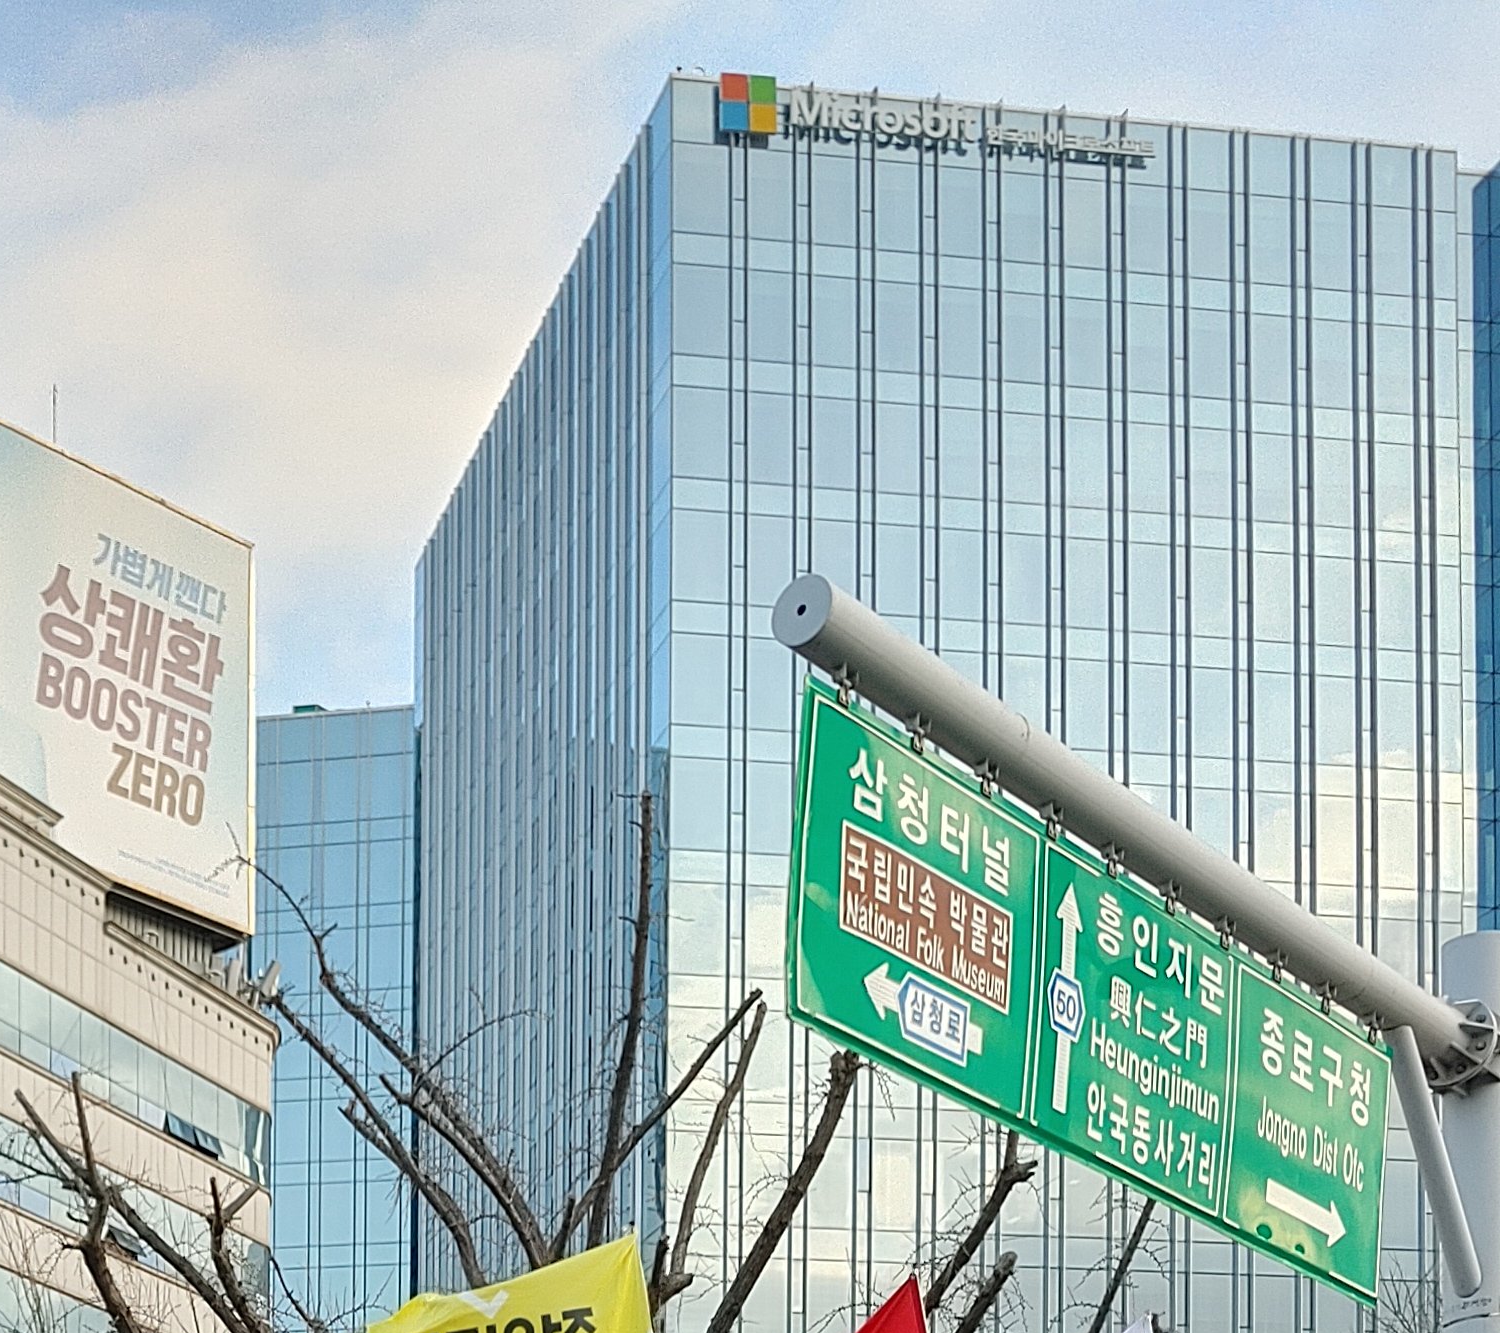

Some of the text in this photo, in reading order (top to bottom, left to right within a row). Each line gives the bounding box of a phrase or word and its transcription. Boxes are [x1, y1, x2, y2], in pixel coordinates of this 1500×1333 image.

[790, 88, 977, 142] Microsoft
[39, 564, 224, 714] 상쾌환
[35, 652, 212, 773] BOOSTER
[106, 742, 205, 828] ZERO
[848, 747, 1011, 896] 삼청터널
[845, 834, 1010, 965] 국립민속 박물관
[846, 895, 1007, 1002] National Folk Museum
[1055, 992, 1078, 1022] 50
[1096, 892, 1225, 1016] 흥인지문
[908, 989, 962, 1044] 삼청로
[1110, 975, 1208, 1070] 興仁之門
[1260, 1009, 1372, 1128] 종로구청
[1090, 1019, 1221, 1126] Heunginjimun
[1086, 1083, 1218, 1201] 안국동사거리
[1257, 1095, 1365, 1194] Jongno Dist Ofc
